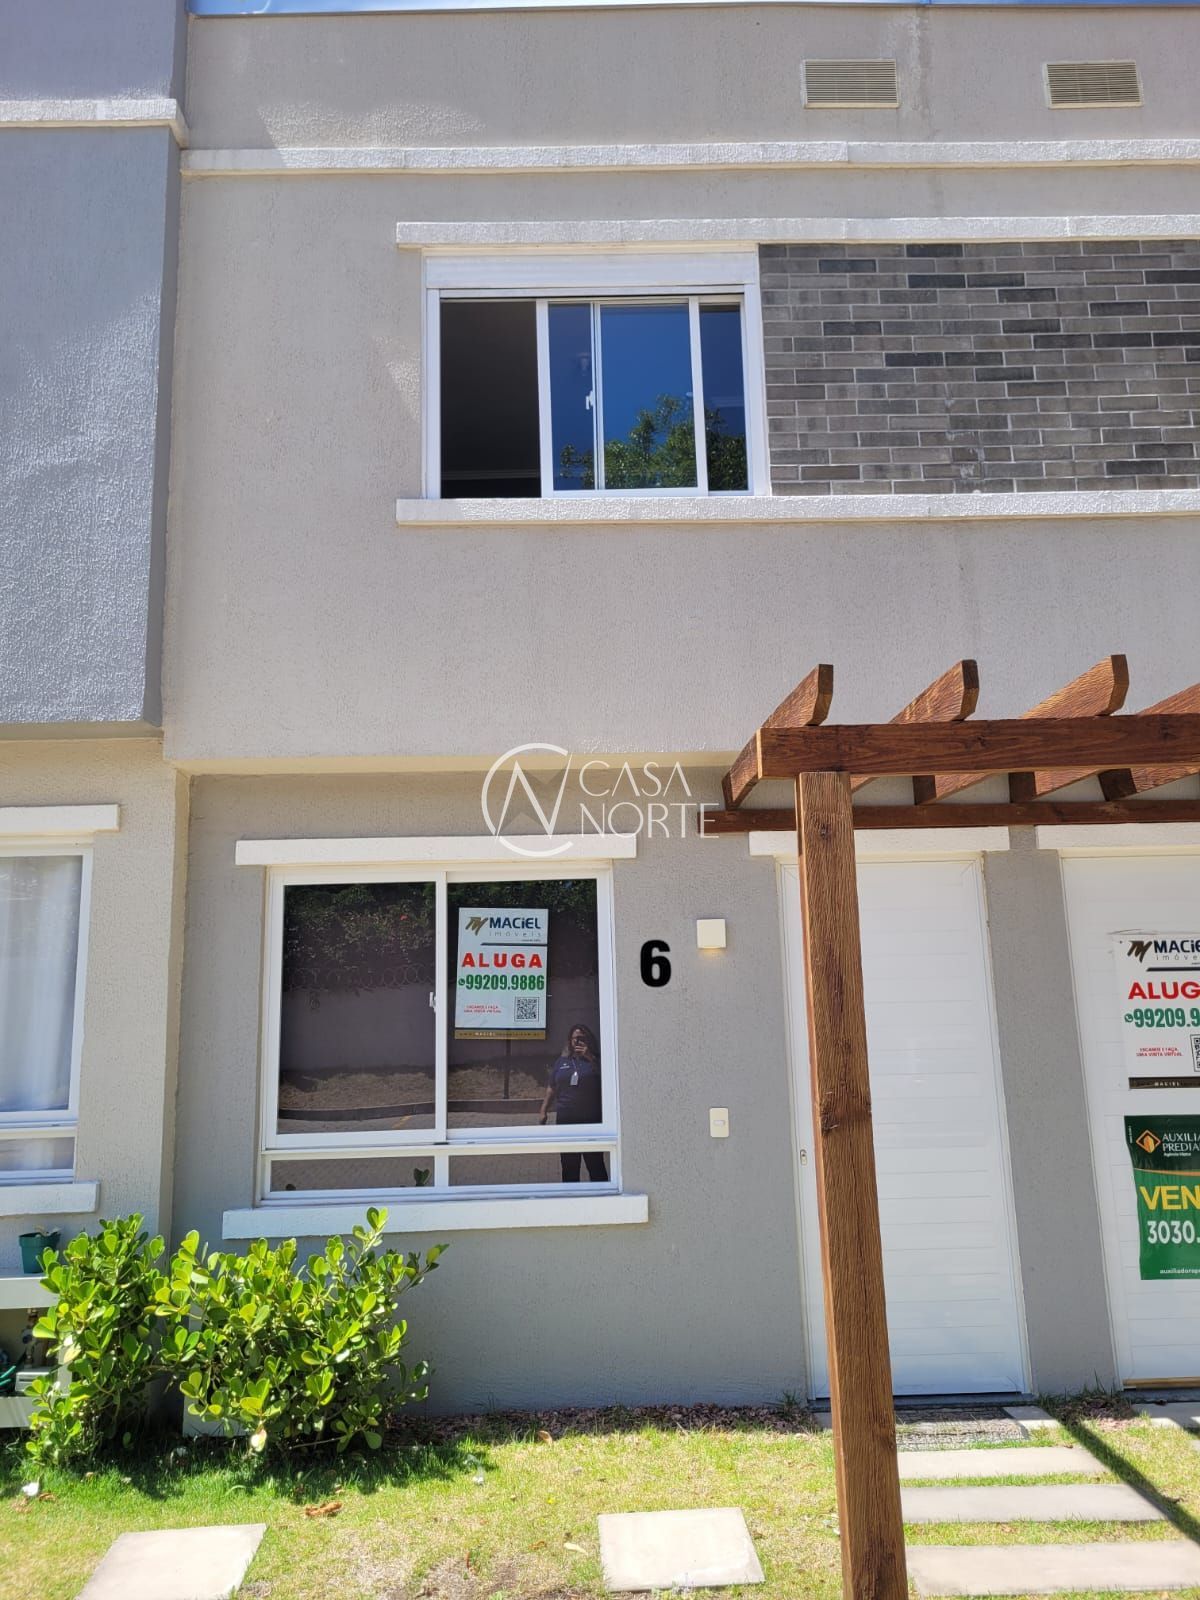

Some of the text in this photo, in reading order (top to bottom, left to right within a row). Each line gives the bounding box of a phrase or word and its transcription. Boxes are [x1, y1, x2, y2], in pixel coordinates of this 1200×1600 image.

[462, 952, 543, 968] ALUGA
[640, 939, 672, 988] 6
[465, 974, 545, 990] 99209.9886
[1128, 981, 1200, 1000] ALUG
[1162, 1142, 1200, 1152] PREDIA
[1139, 1185, 1200, 1210] VEN
